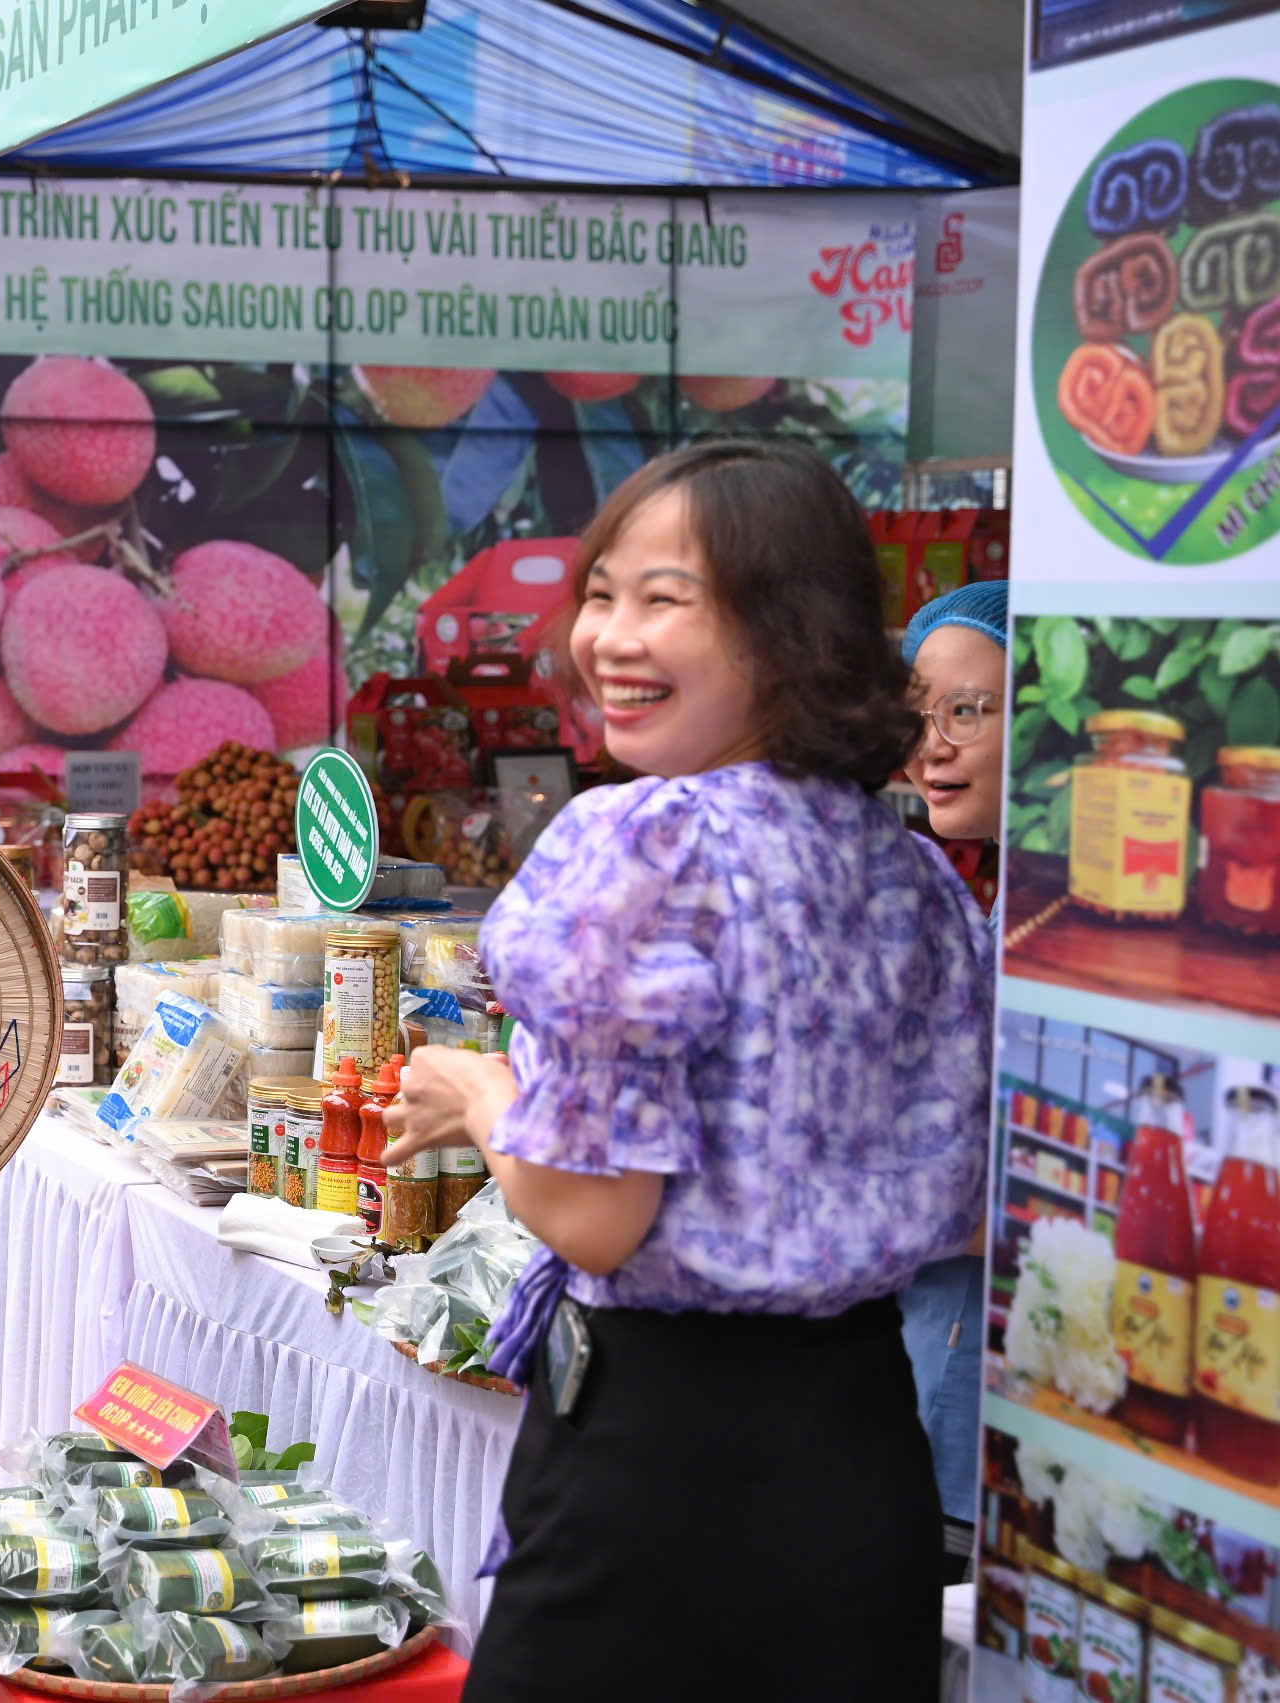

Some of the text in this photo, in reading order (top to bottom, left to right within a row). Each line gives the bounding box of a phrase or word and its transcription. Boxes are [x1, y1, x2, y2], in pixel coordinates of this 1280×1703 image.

[111, 183, 178, 244] XÚC
[188, 185, 262, 247] TIẾN
[352, 206, 416, 264] THỤ
[425, 196, 478, 257] VẢI
[587, 203, 648, 265] BẮC
[657, 219, 748, 269] GIANG
[5, 264, 50, 334] HỆ
[59, 264, 172, 328] THỐNG
[183, 280, 304, 332] SAIGON
[313, 286, 409, 335] CO.OP
[417, 281, 498, 339] TRÊN
[507, 285, 589, 342] TOÀN
[598, 284, 680, 345] QUỐC
[108, 1374, 134, 1398] NEM
[98, 1401, 132, 1427] OCOP
